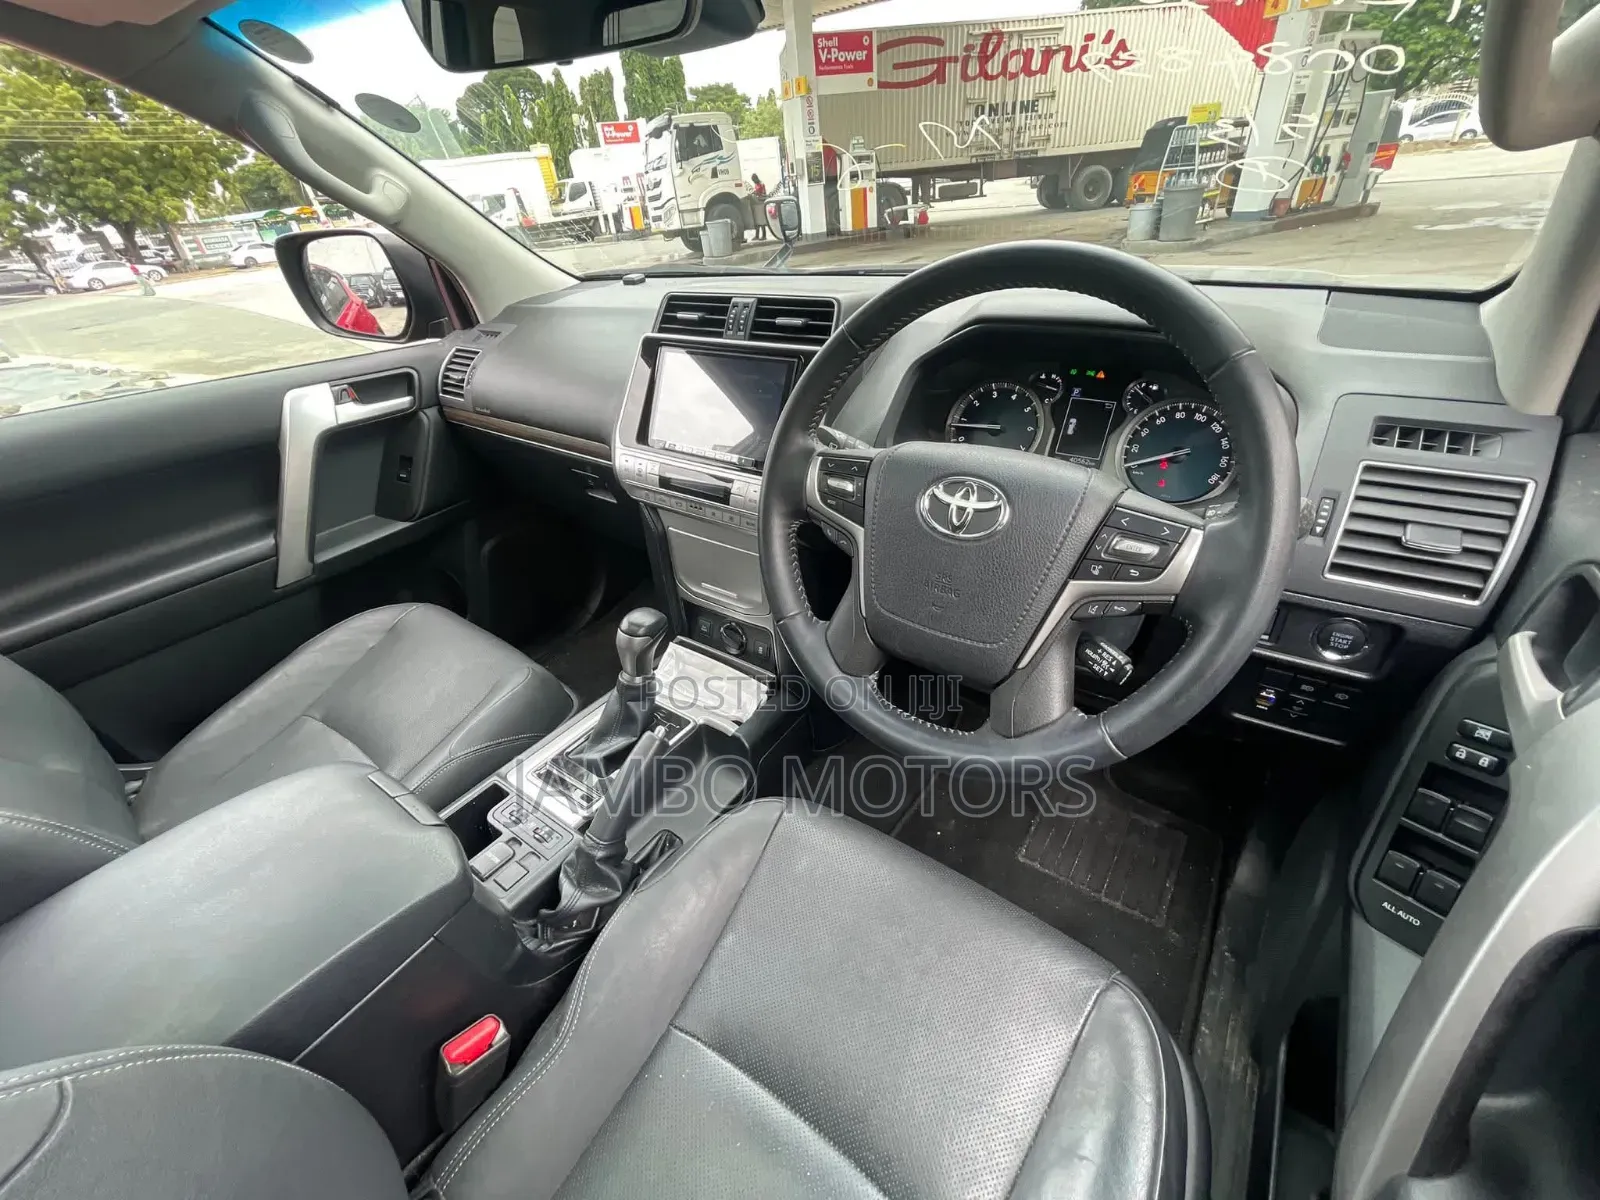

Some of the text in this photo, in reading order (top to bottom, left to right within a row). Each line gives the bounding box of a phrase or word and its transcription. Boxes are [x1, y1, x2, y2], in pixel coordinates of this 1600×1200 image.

[817, 36, 839, 48] Shell
[818, 47, 868, 63] V-Power
[876, 28, 1137, 90] Gilani's
[974, 99, 1039, 117] ONLINE
[1155, 416, 1166, 425] 60
[1175, 411, 1186, 419] 80
[1193, 412, 1207, 423] 100
[1140, 428, 1150, 438] 40
[1210, 422, 1223, 434] 120
[1131, 444, 1140, 453] 20
[1220, 437, 1230, 450] 140
[1219, 456, 1230, 468] 160
[1207, 472, 1220, 485] 180
[1329, 636, 1353, 645] START
[1331, 631, 1354, 639] ENGINE
[1329, 641, 1349, 649] STOP
[1092, 663, 1105, 673] SET
[1381, 901, 1421, 926] ALL AUTO
